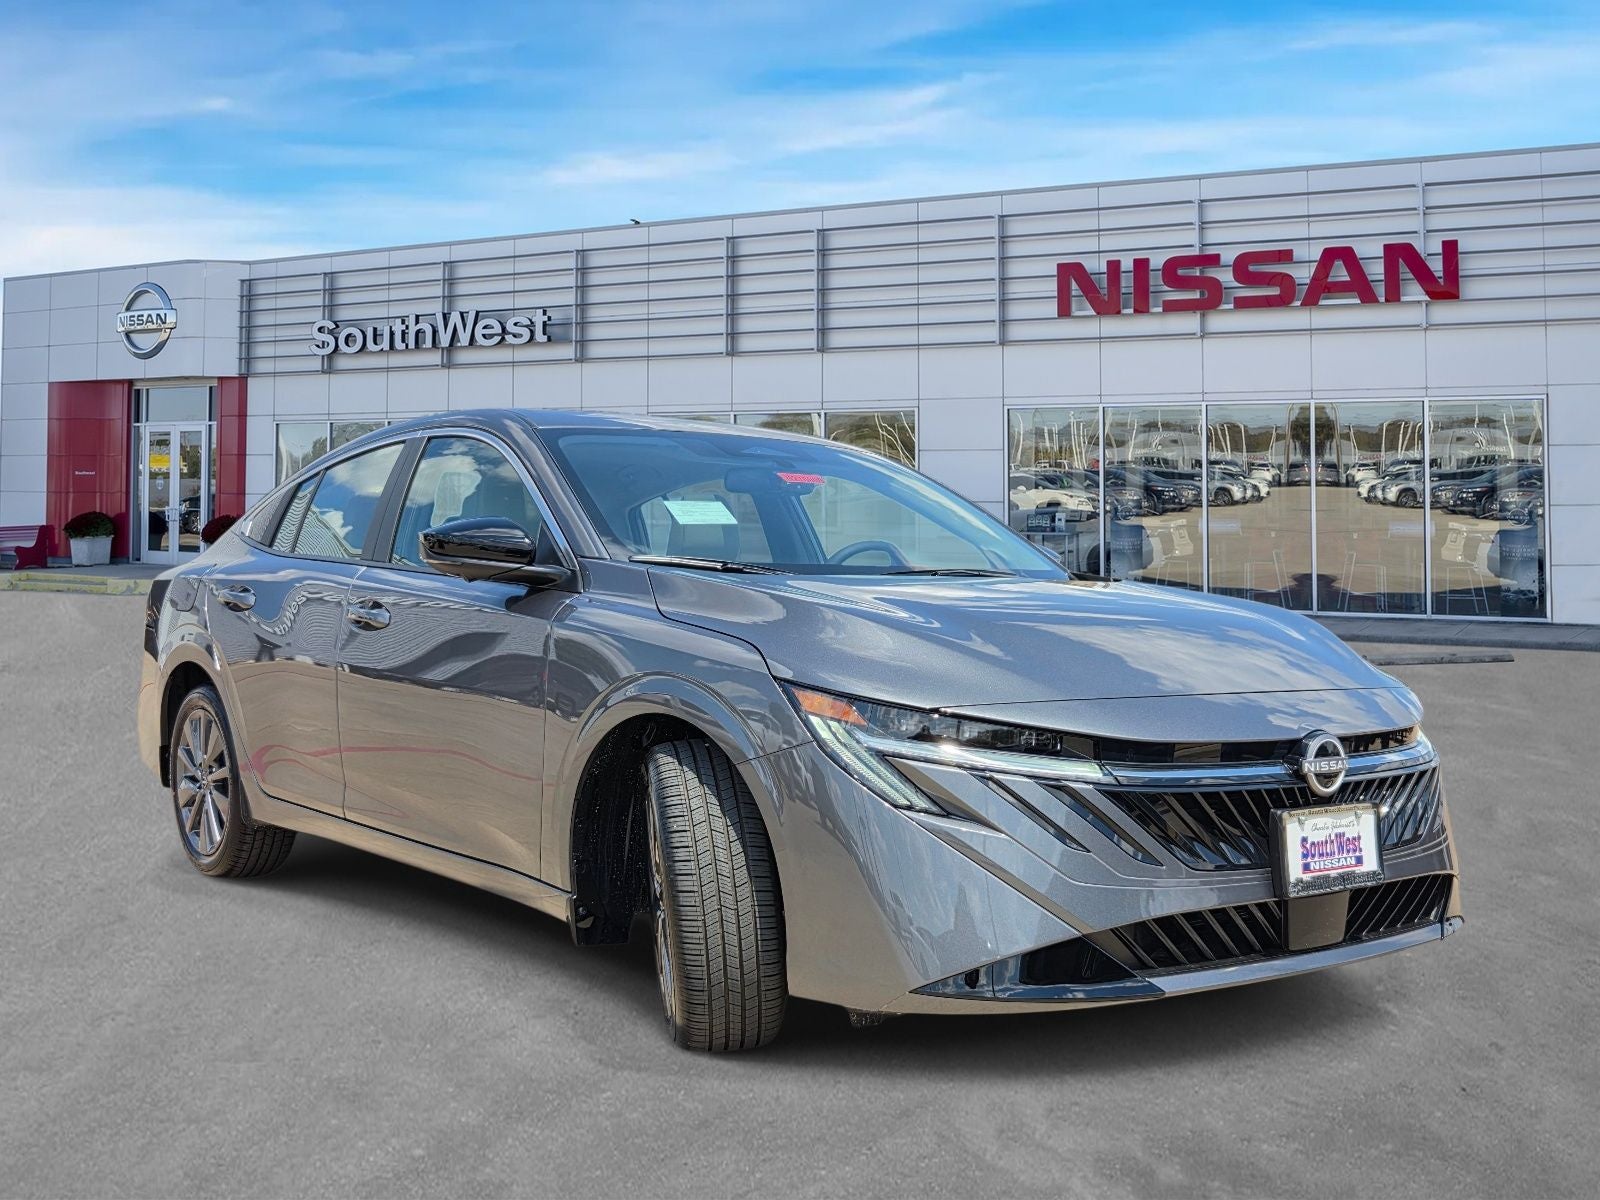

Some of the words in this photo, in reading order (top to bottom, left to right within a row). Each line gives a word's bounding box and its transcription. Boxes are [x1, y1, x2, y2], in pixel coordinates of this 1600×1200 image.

[1056, 239, 1461, 318] NISSAN
[118, 312, 167, 328] NISSAN
[309, 308, 551, 356] SouthWest
[1300, 831, 1363, 861] SouthWest
[1309, 856, 1356, 871] NISSAN
